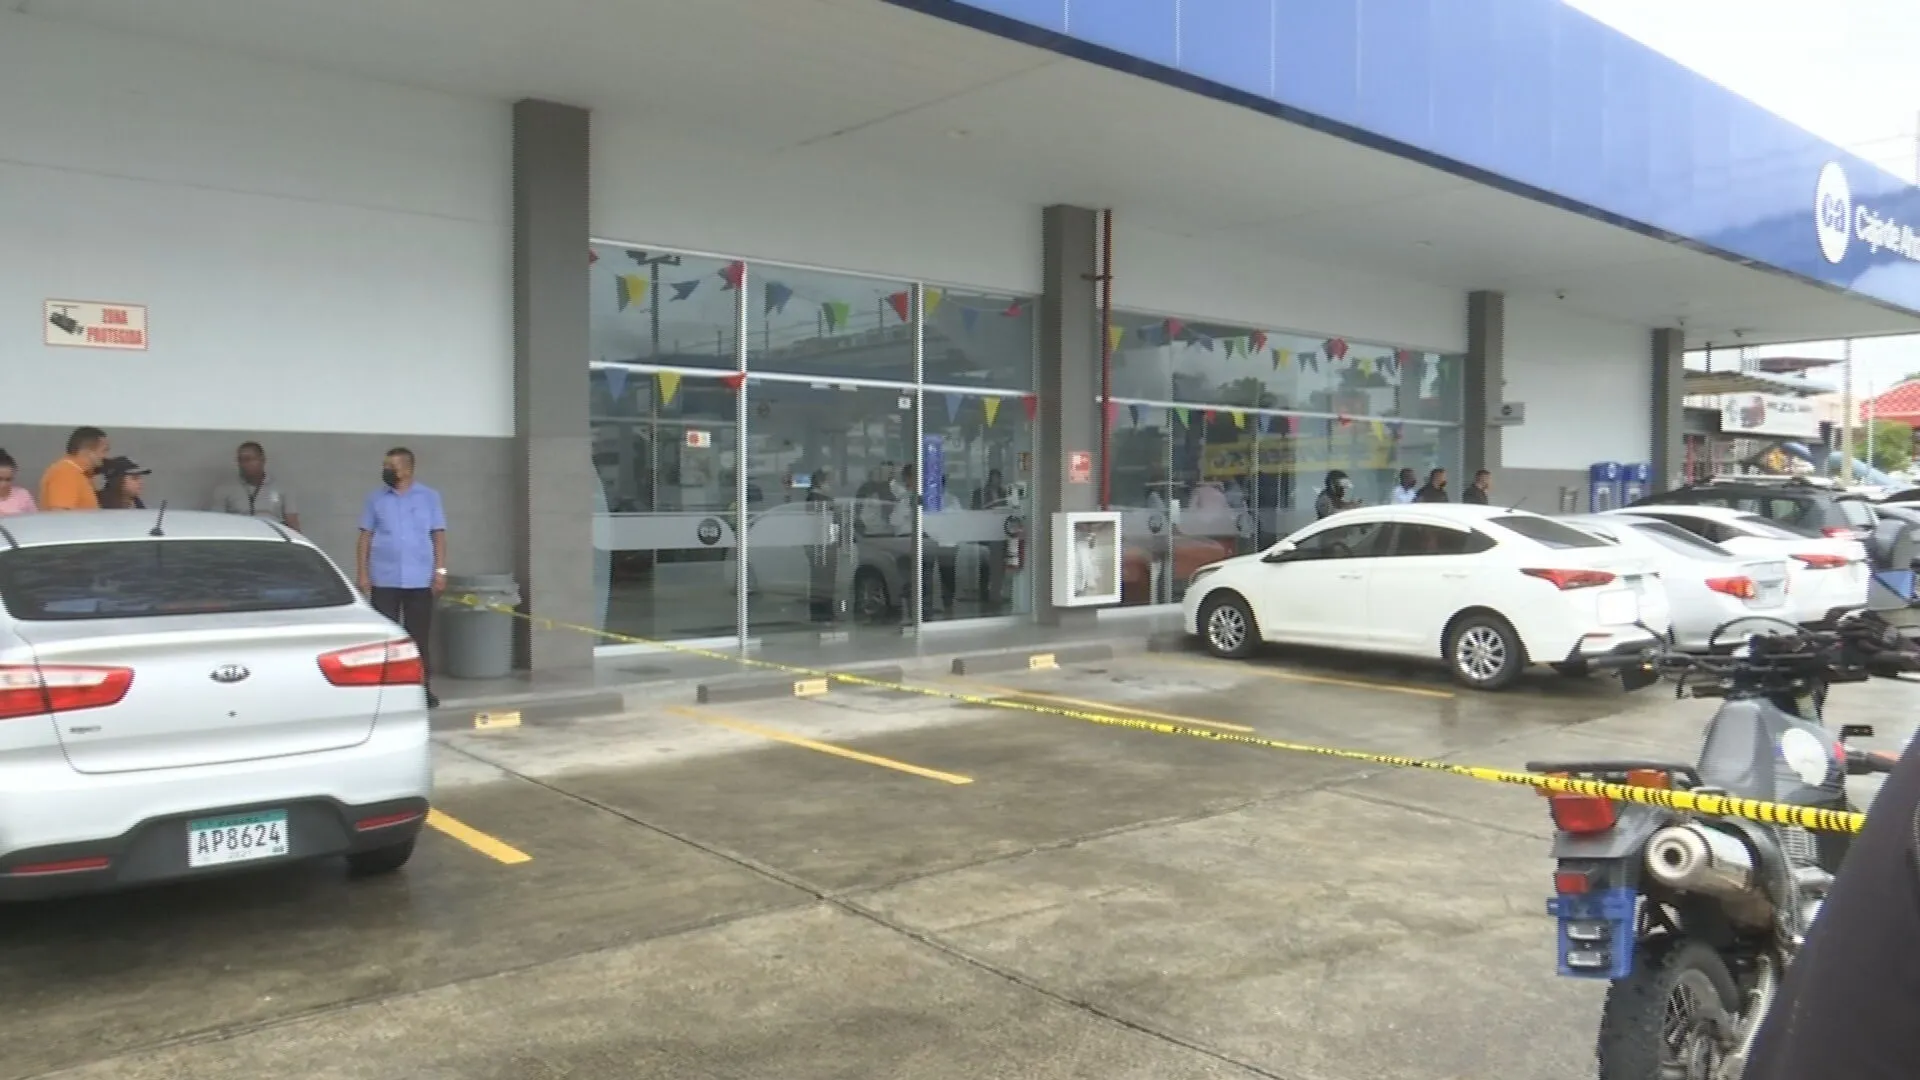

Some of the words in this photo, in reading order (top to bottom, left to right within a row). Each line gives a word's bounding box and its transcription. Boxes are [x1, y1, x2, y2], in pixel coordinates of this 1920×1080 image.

[1821, 191, 1845, 234] ca
[1855, 204, 1886, 254] Caja
[1885, 219, 1901, 254] de
[103, 308, 128, 325] ZONA
[87, 326, 142, 345] PROTEGIDA
[197, 821, 281, 855] AP8624
